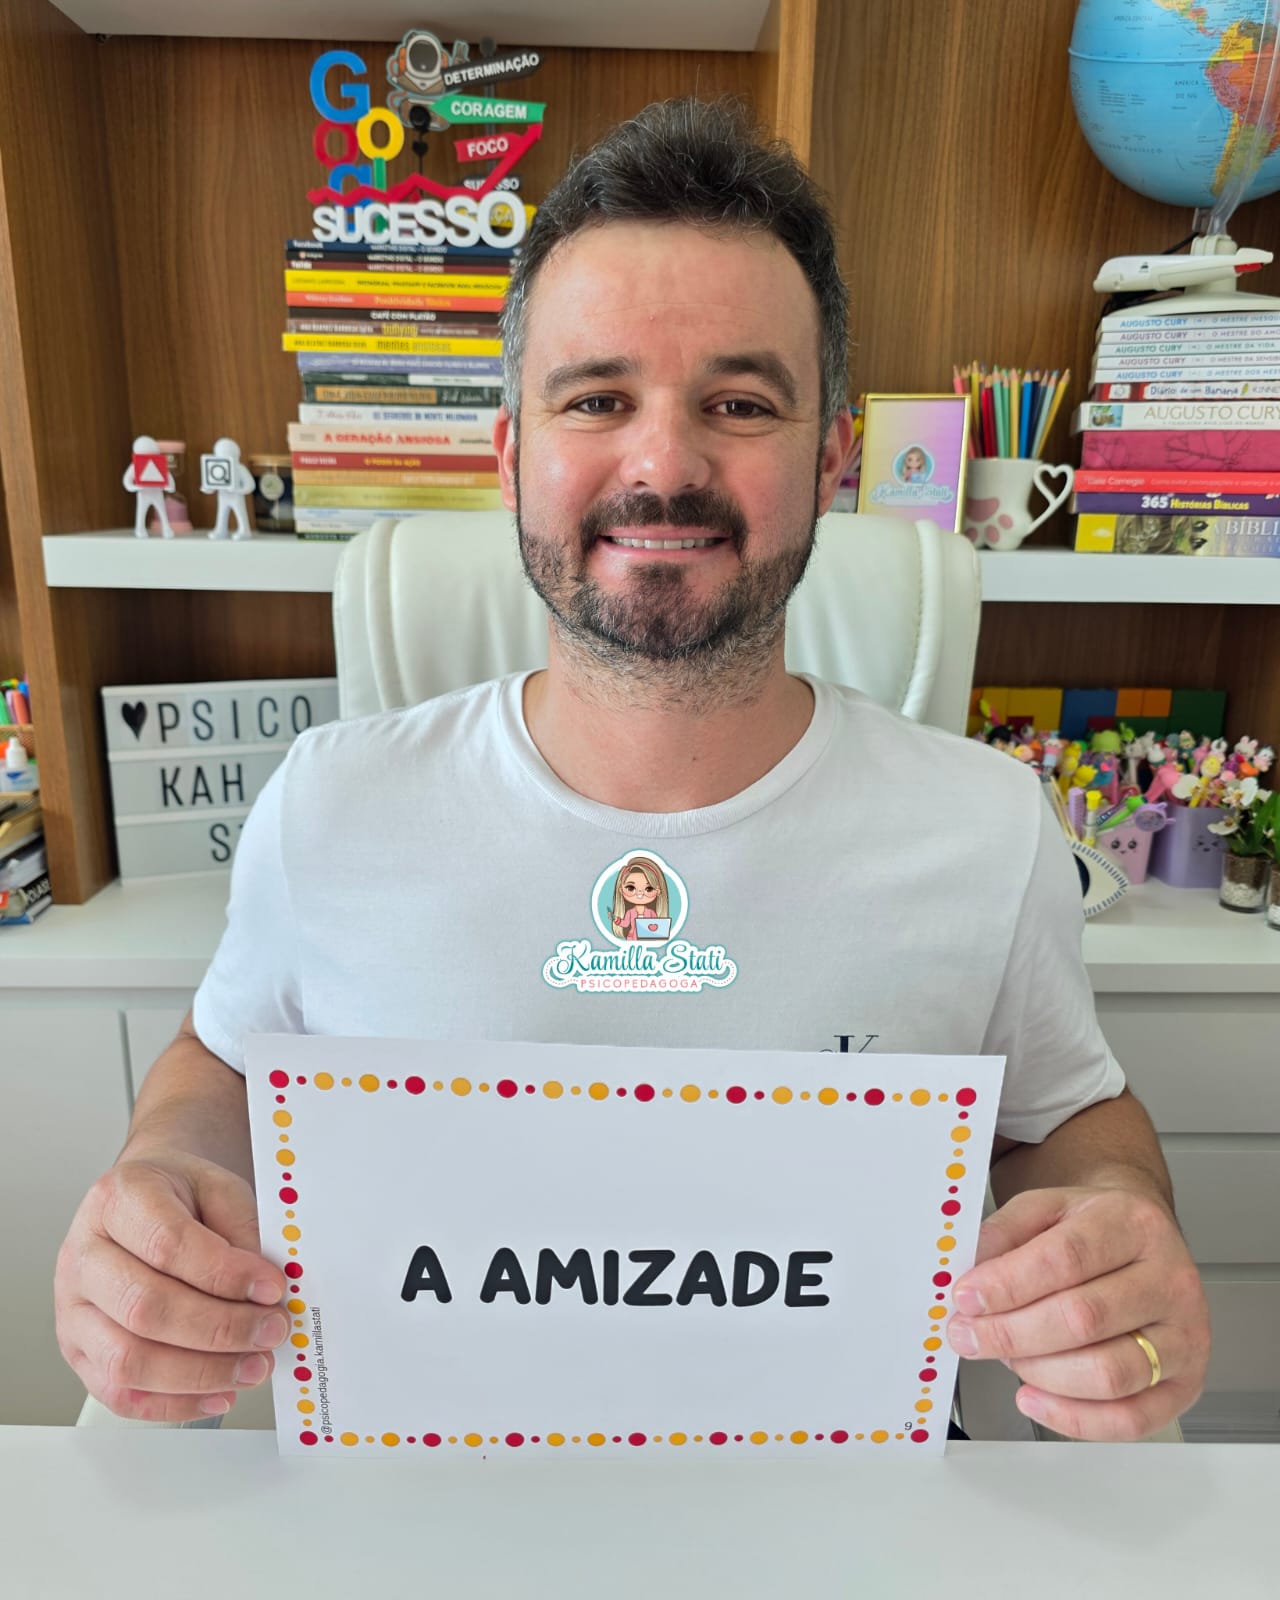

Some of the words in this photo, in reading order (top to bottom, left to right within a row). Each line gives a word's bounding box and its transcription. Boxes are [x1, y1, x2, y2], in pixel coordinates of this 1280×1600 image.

[444, 53, 540, 86] DETERMINAÇÃO
[450, 101, 527, 120] CORAGEM
[467, 137, 509, 158] FOCO
[312, 190, 526, 249] SUCESSO
[1120, 319, 1162, 328] AUGUSTO
[1164, 317, 1188, 326] CURY
[1120, 332, 1162, 340] AUGUSTO
[1164, 331, 1188, 339] CURY
[1115, 345, 1157, 353] AUGUSTO
[1159, 344, 1182, 352] CURY
[1118, 358, 1160, 366] AUGUSTO
[1163, 357, 1186, 365] CURY
[1116, 371, 1157, 379] AUGUSTO
[1160, 370, 1183, 378] CURY
[1150, 385, 1176, 396] Diário
[1205, 385, 1239, 396] Banana
[1144, 405, 1232, 420] AUGUSTO
[324, 432, 333, 443] A
[336, 432, 393, 446] GERAÇÃO
[396, 434, 450, 445] ANSIOSA
[1141, 494, 1169, 508] 365
[158, 696, 312, 743] PSICO
[160, 763, 244, 807] KAH
[210, 823, 244, 862] S
[400, 1245, 452, 1303] A
[480, 1247, 834, 1308] AMIZADE
[904, 1421, 913, 1431] 9
